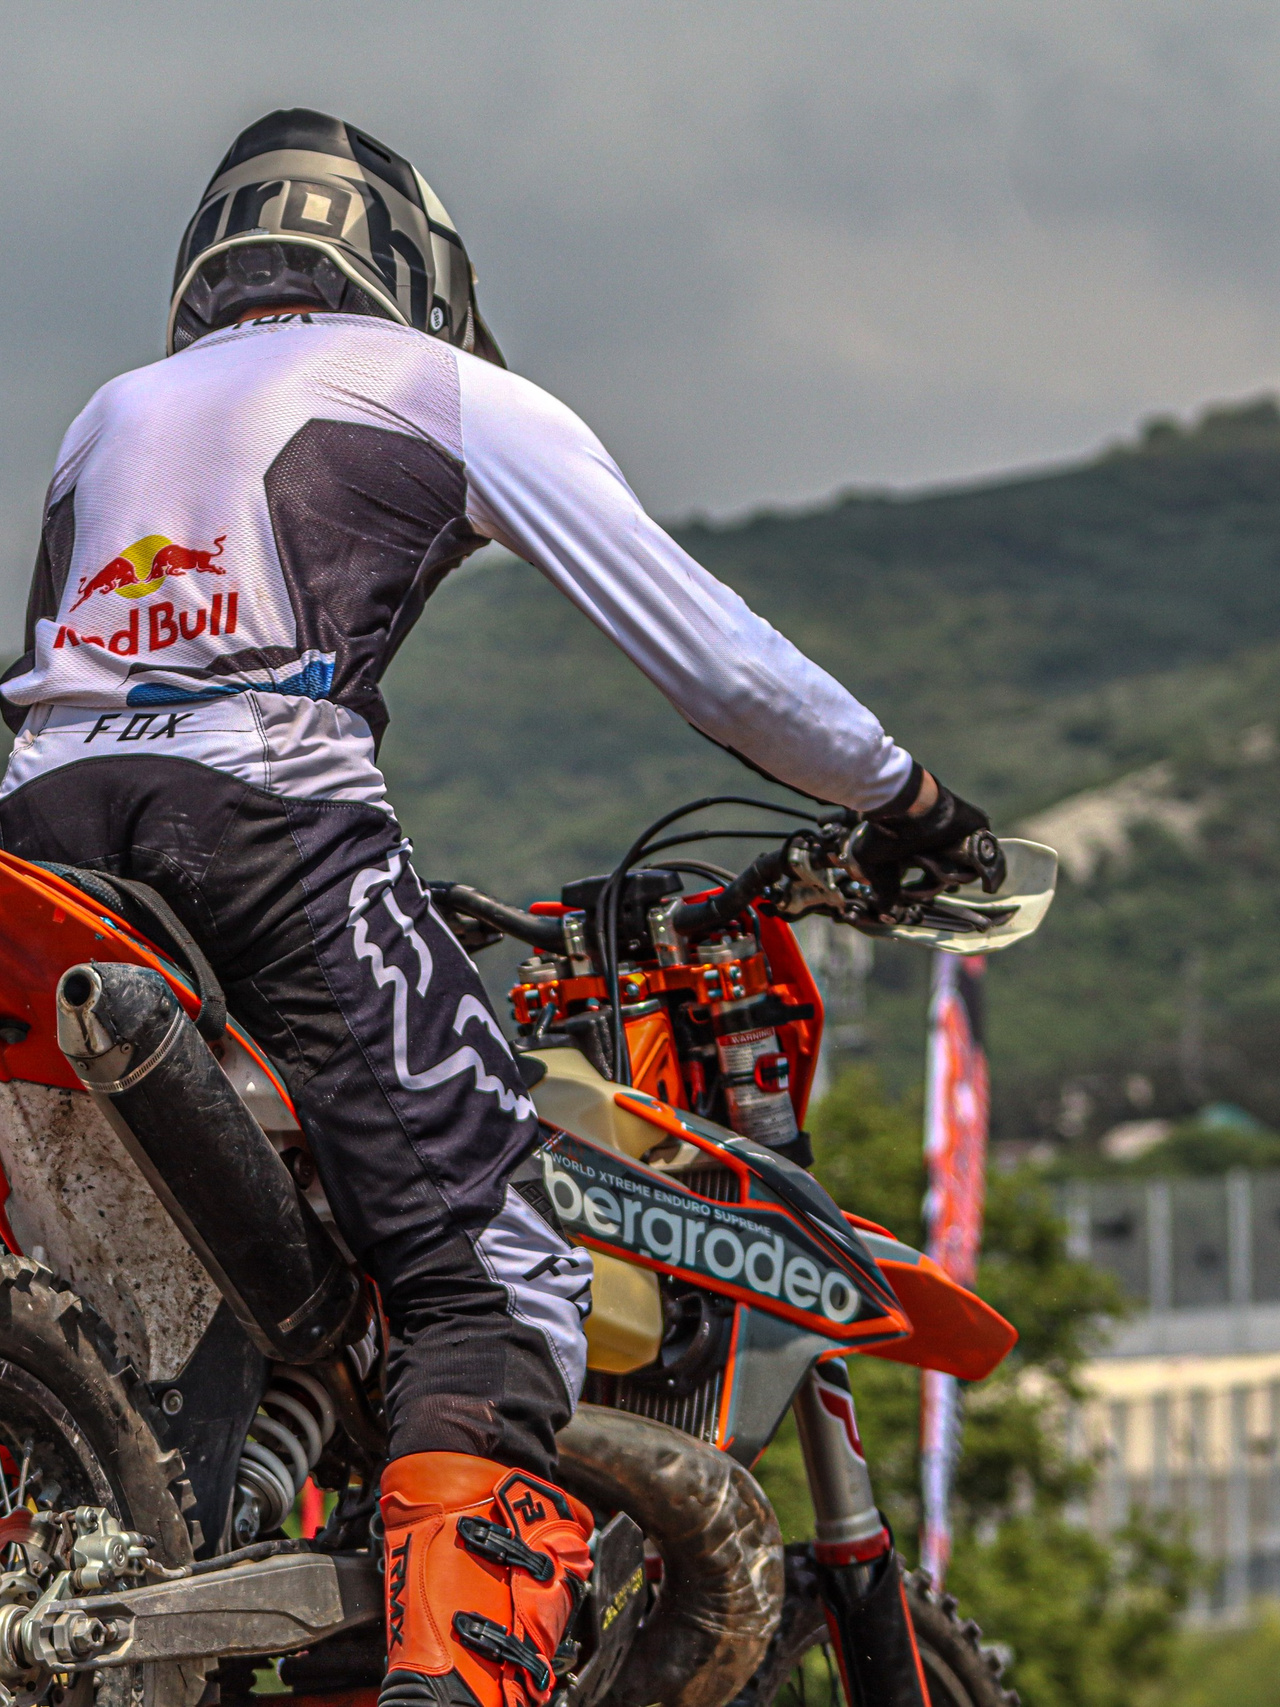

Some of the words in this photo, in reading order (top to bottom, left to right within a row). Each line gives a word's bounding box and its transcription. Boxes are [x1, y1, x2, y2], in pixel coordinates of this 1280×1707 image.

[148, 592, 238, 651] Bull
[84, 713, 194, 743] FOX
[731, 1027, 776, 1044] WARNING
[550, 1152, 596, 1178] WORLD
[599, 1171, 651, 1197] XTREME
[653, 1189, 711, 1216] ENDURO
[714, 1209, 771, 1237] SUPREME
[543, 1151, 859, 1323] bergrodeo
